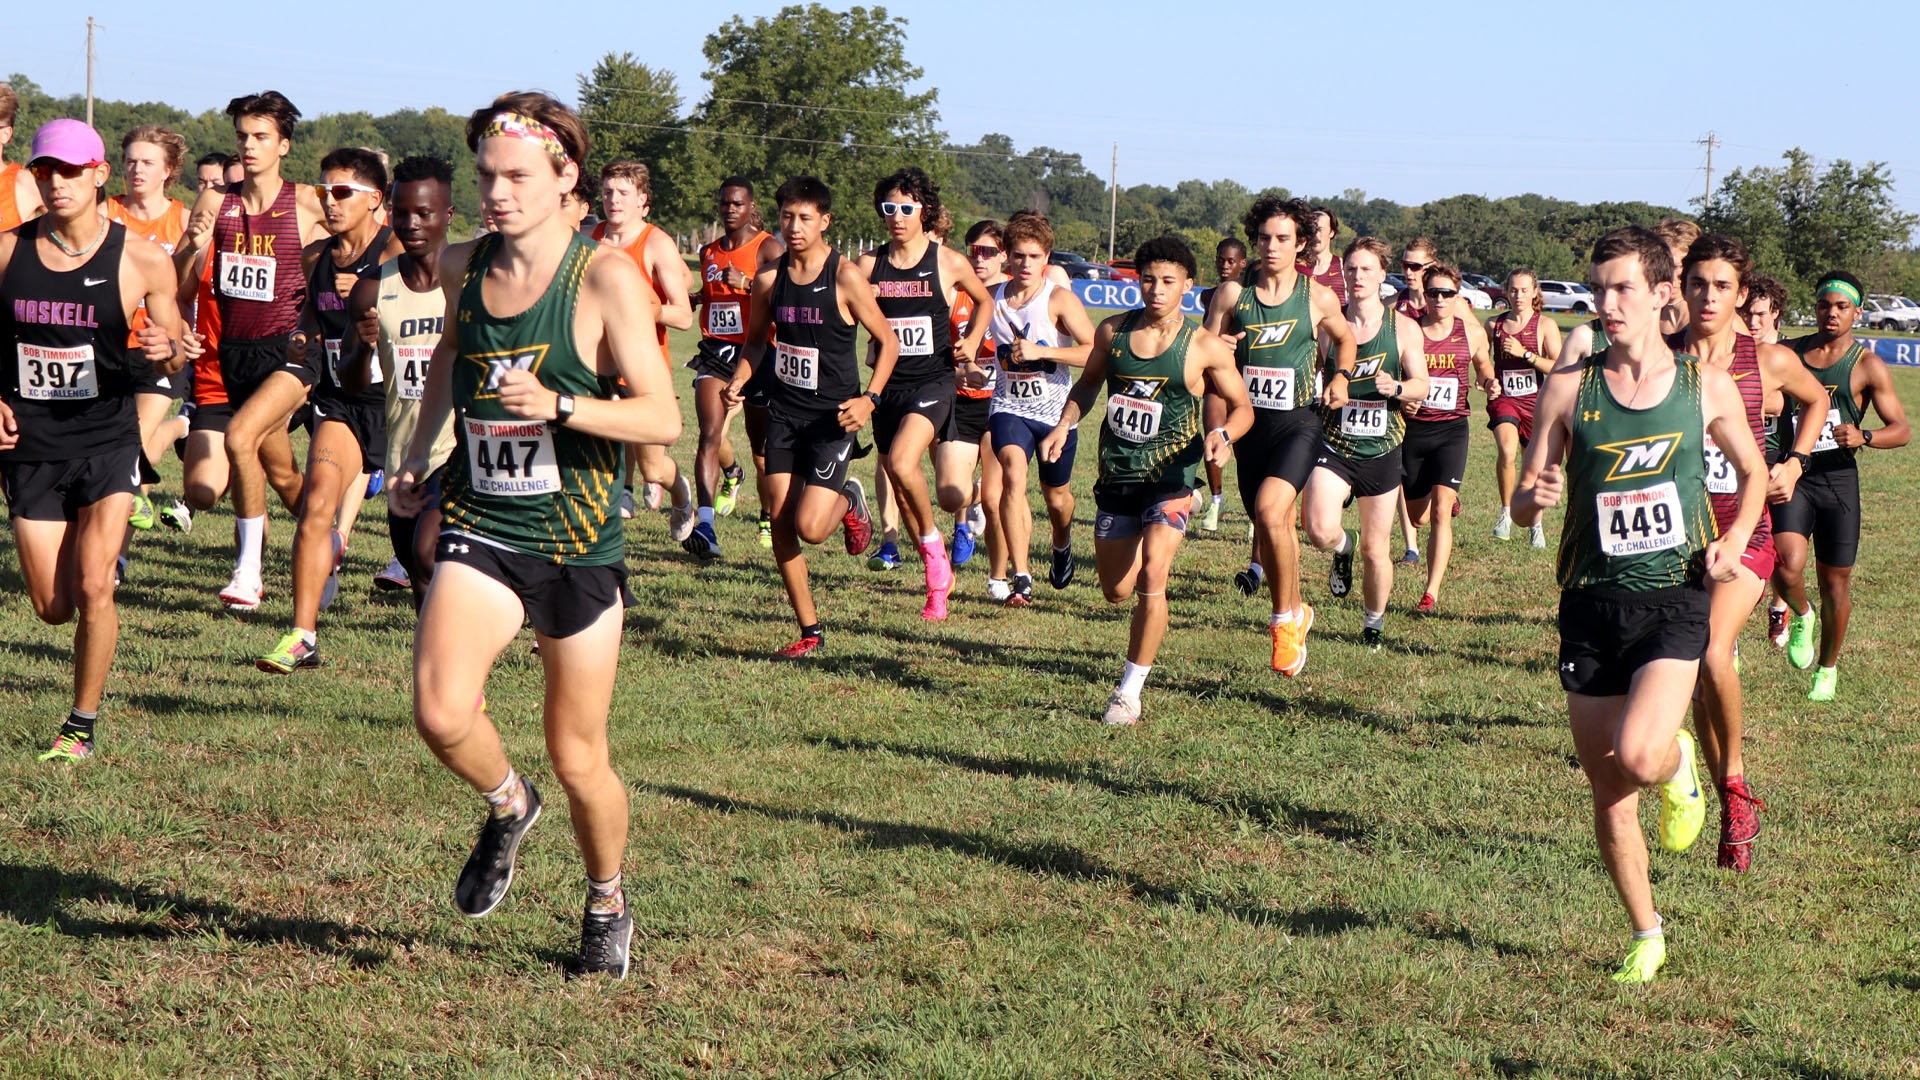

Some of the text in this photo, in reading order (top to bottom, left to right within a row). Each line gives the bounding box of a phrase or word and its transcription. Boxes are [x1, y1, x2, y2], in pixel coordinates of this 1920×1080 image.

[234, 232, 276, 256] PRK
[226, 255, 271, 267] BOB TIMMONS
[227, 265, 268, 291] 466
[235, 289, 267, 299] CHALLENGE
[878, 280, 933, 298] HASKELL
[1084, 284, 1144, 307] CRO
[14, 299, 99, 329] HASKELL
[712, 310, 737, 328] 393
[900, 319, 928, 327] TIMMONS
[1258, 324, 1290, 344] M
[23, 346, 87, 360] BOB TIMMONS
[398, 348, 415, 357] BOB
[788, 346, 815, 357] TIMMONS
[780, 353, 811, 380] 396
[1354, 358, 1381, 378] M
[1424, 353, 1456, 369] PARK
[28, 359, 84, 388] 397
[1260, 369, 1290, 378] TIMMONS
[1507, 375, 1533, 390] 460
[28, 388, 90, 398] XC CHALLENGE
[404, 388, 414, 397] XC
[1010, 380, 1042, 398] 426
[1128, 381, 1160, 397] M
[1249, 377, 1287, 400] 442
[1112, 396, 1157, 413] BOB TIMMONS
[1113, 406, 1153, 435] 440
[1347, 408, 1382, 428] 446
[469, 422, 543, 437] BOB TIMMONS
[477, 440, 540, 478] 447
[1619, 440, 1671, 473] M
[479, 479, 550, 492] XC CHALLENGE
[1603, 487, 1671, 507] BOB TIMMONS
[1610, 502, 1673, 540] 449
[1611, 534, 1677, 554] XC CHALLENGE
